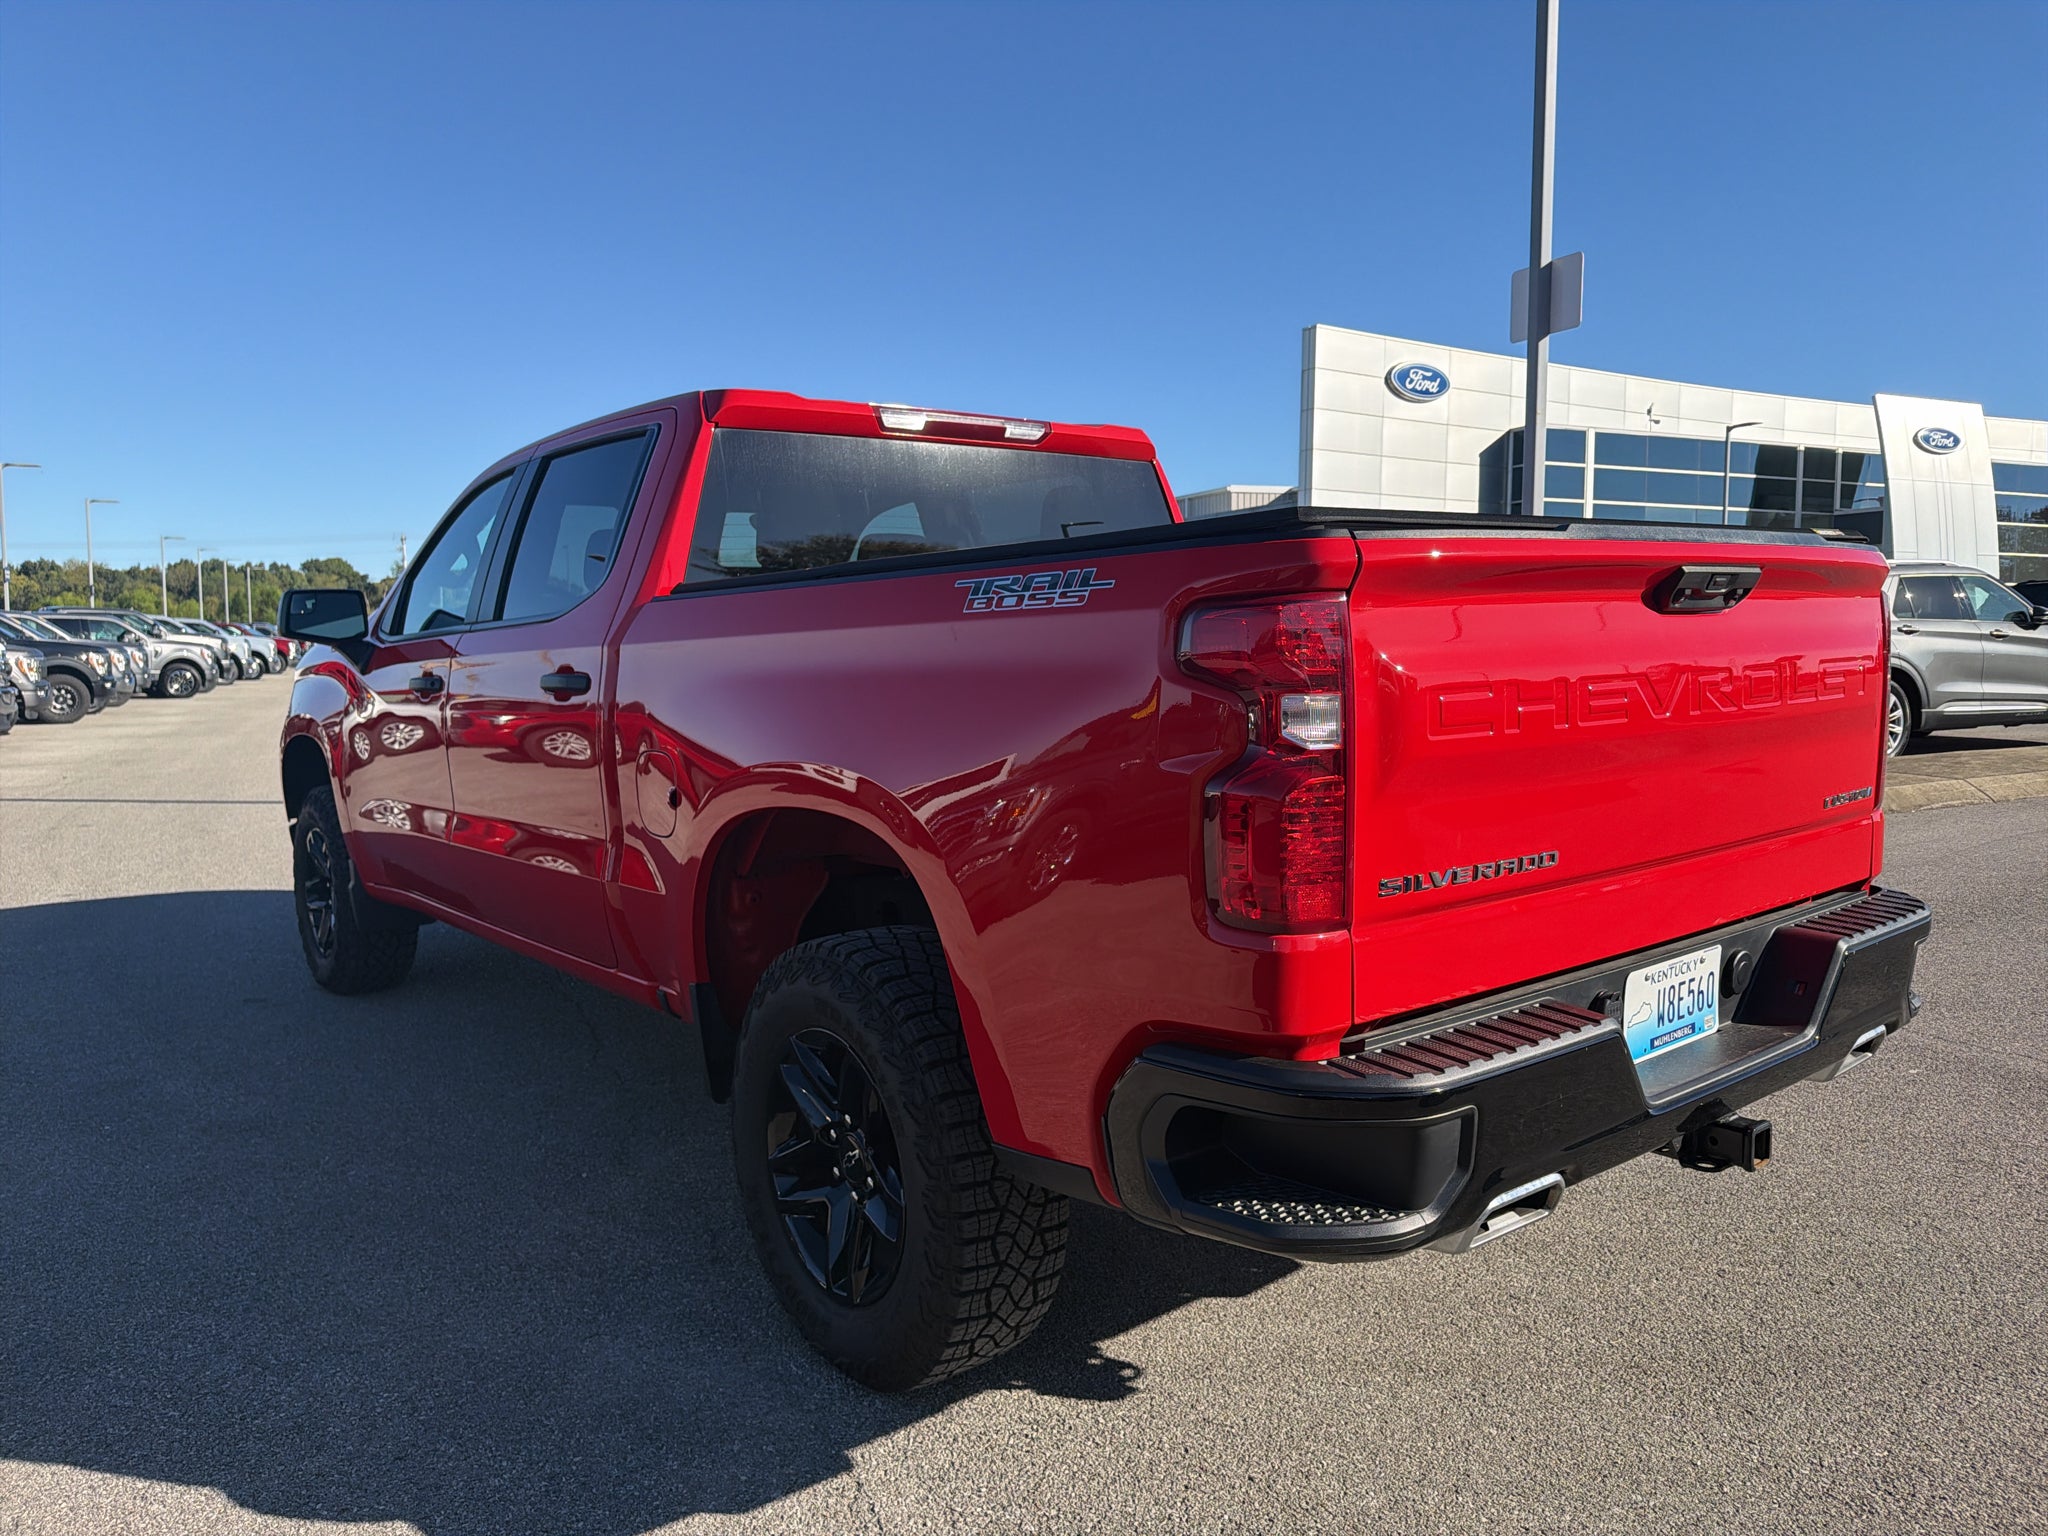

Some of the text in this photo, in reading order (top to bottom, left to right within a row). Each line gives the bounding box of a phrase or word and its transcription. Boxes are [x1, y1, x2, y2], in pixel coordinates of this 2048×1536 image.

[1405, 368, 1440, 393] Ford
[1929, 431, 1954, 446] Ford
[955, 568, 1115, 597] TRAIL
[963, 589, 1091, 613] BOSS
[1427, 655, 1874, 741] CHEVROLET
[1378, 850, 1559, 898] SILVERADO
[1650, 958, 1699, 985] KENTUCKY
[1657, 971, 1715, 1028] W8E560
[1653, 1025, 1693, 1048] MUHLENBERG
